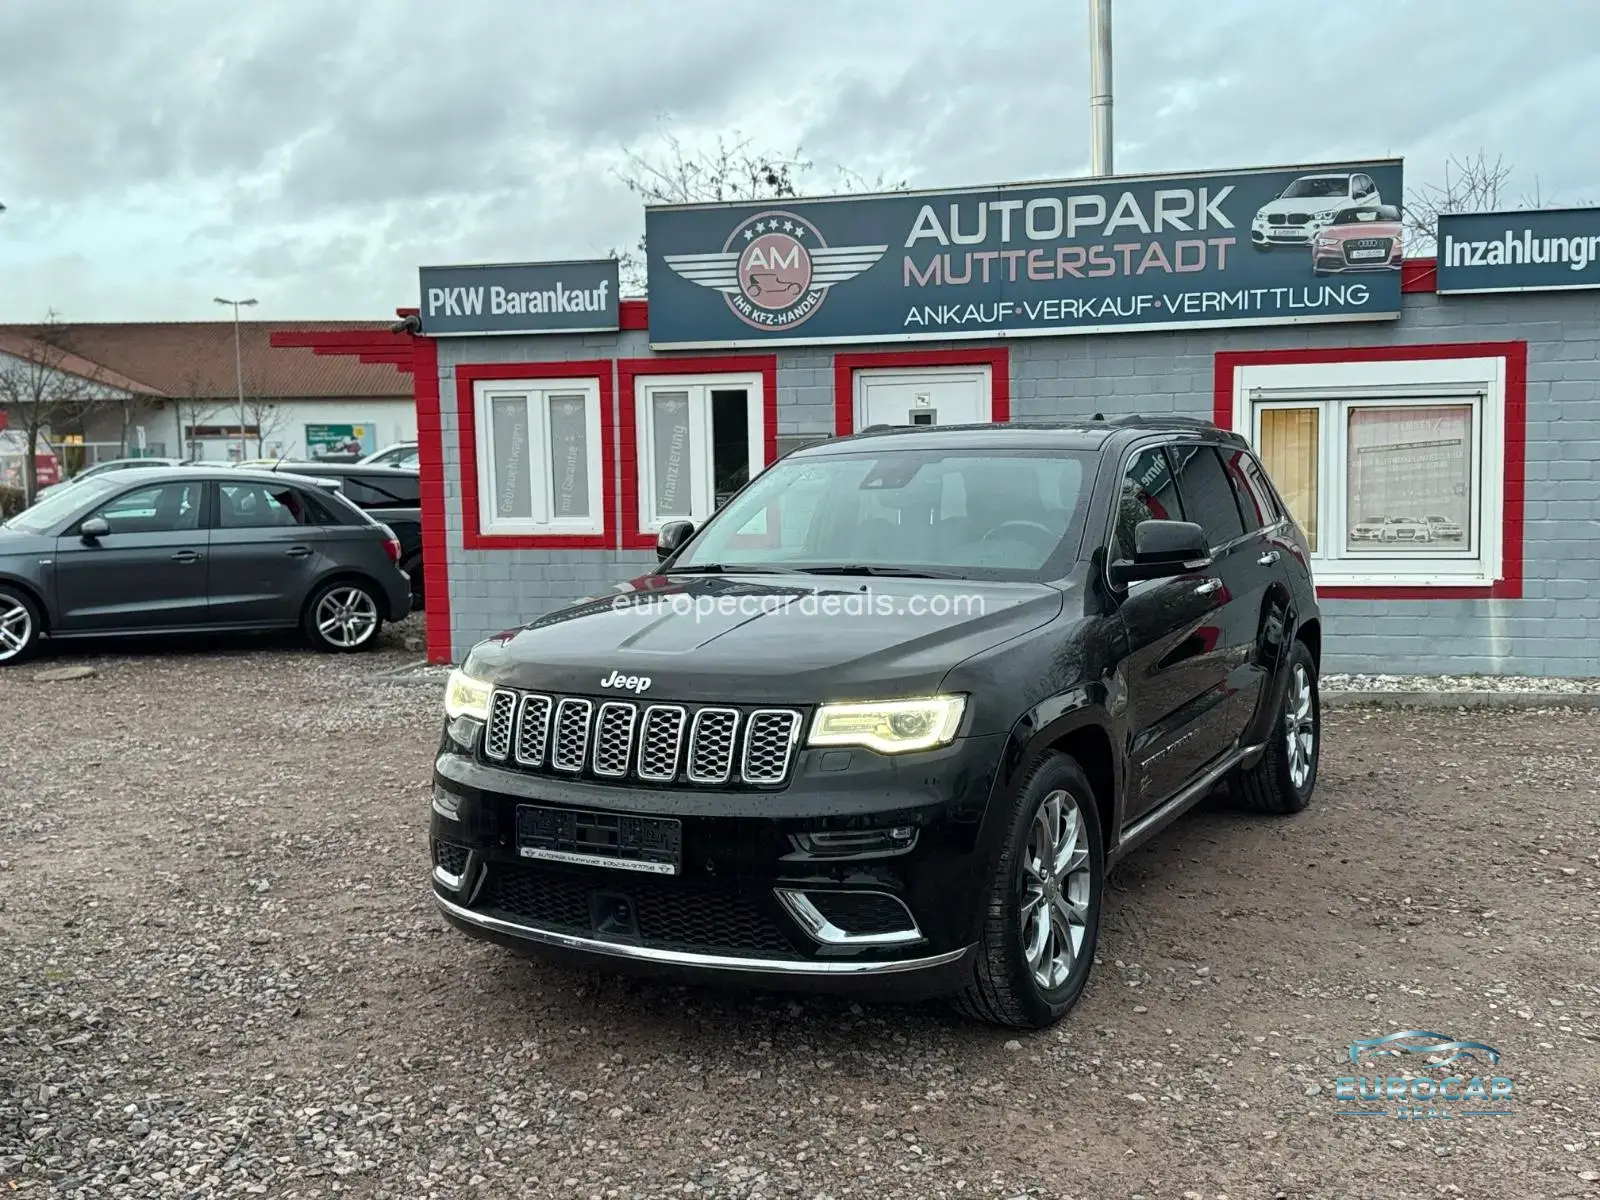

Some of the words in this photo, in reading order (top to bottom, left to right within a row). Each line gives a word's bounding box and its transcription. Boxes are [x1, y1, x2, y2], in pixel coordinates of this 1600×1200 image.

[903, 185, 1236, 248] AUTOPARK
[745, 245, 799, 271] AM
[903, 237, 1236, 288] MUTTERSTADT
[428, 286, 484, 317] PKW
[490, 280, 609, 315] Barankauf
[733, 295, 752, 316] IHR
[752, 291, 821, 325] KFZ-HANDEL
[903, 302, 1014, 326] ANKAUF
[1023, 295, 1153, 320] VERKAUF
[1163, 284, 1370, 314] VERMITTLUNG
[660, 424, 687, 510] Finanzierung
[601, 670, 651, 694] Jeep
